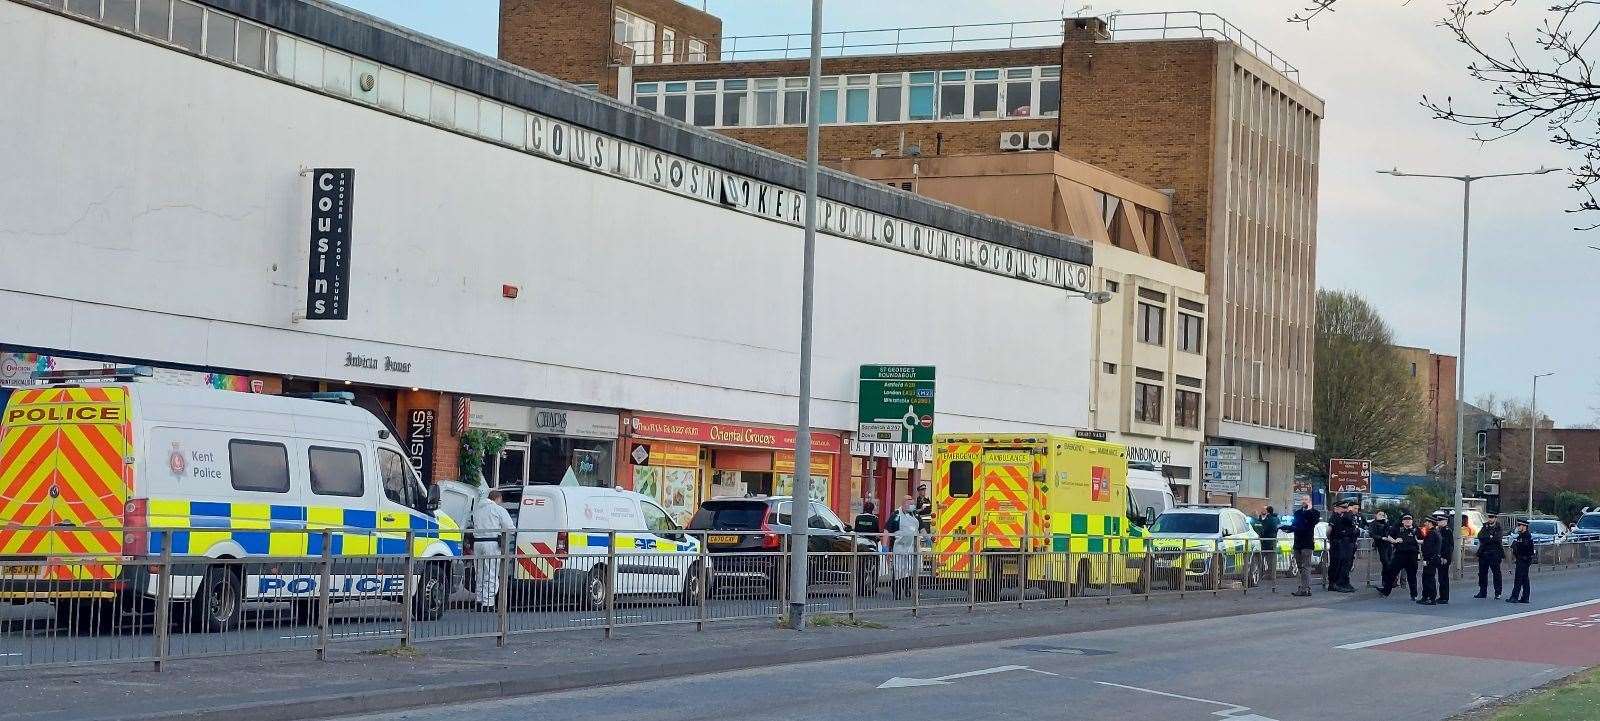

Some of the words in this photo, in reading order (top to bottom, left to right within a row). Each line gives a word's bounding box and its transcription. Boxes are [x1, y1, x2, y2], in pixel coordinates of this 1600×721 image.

[531, 115, 662, 183] COUSINS
[824, 203, 877, 240] POOL
[314, 173, 334, 314] Cousins
[900, 222, 976, 266] LOUNGE
[993, 243, 1074, 286] COUSINS
[384, 356, 412, 373] House
[9, 406, 121, 423] POLICE
[424, 410, 434, 438] Lounge
[709, 424, 744, 442] Oriental
[744, 428, 776, 445] Grocers
[191, 450, 214, 462] Kent
[943, 452, 979, 460] EMERGENCY
[989, 453, 1027, 462] AMBULANCE
[1126, 445, 1171, 463] ARNBOROUGH
[193, 467, 222, 479] Police
